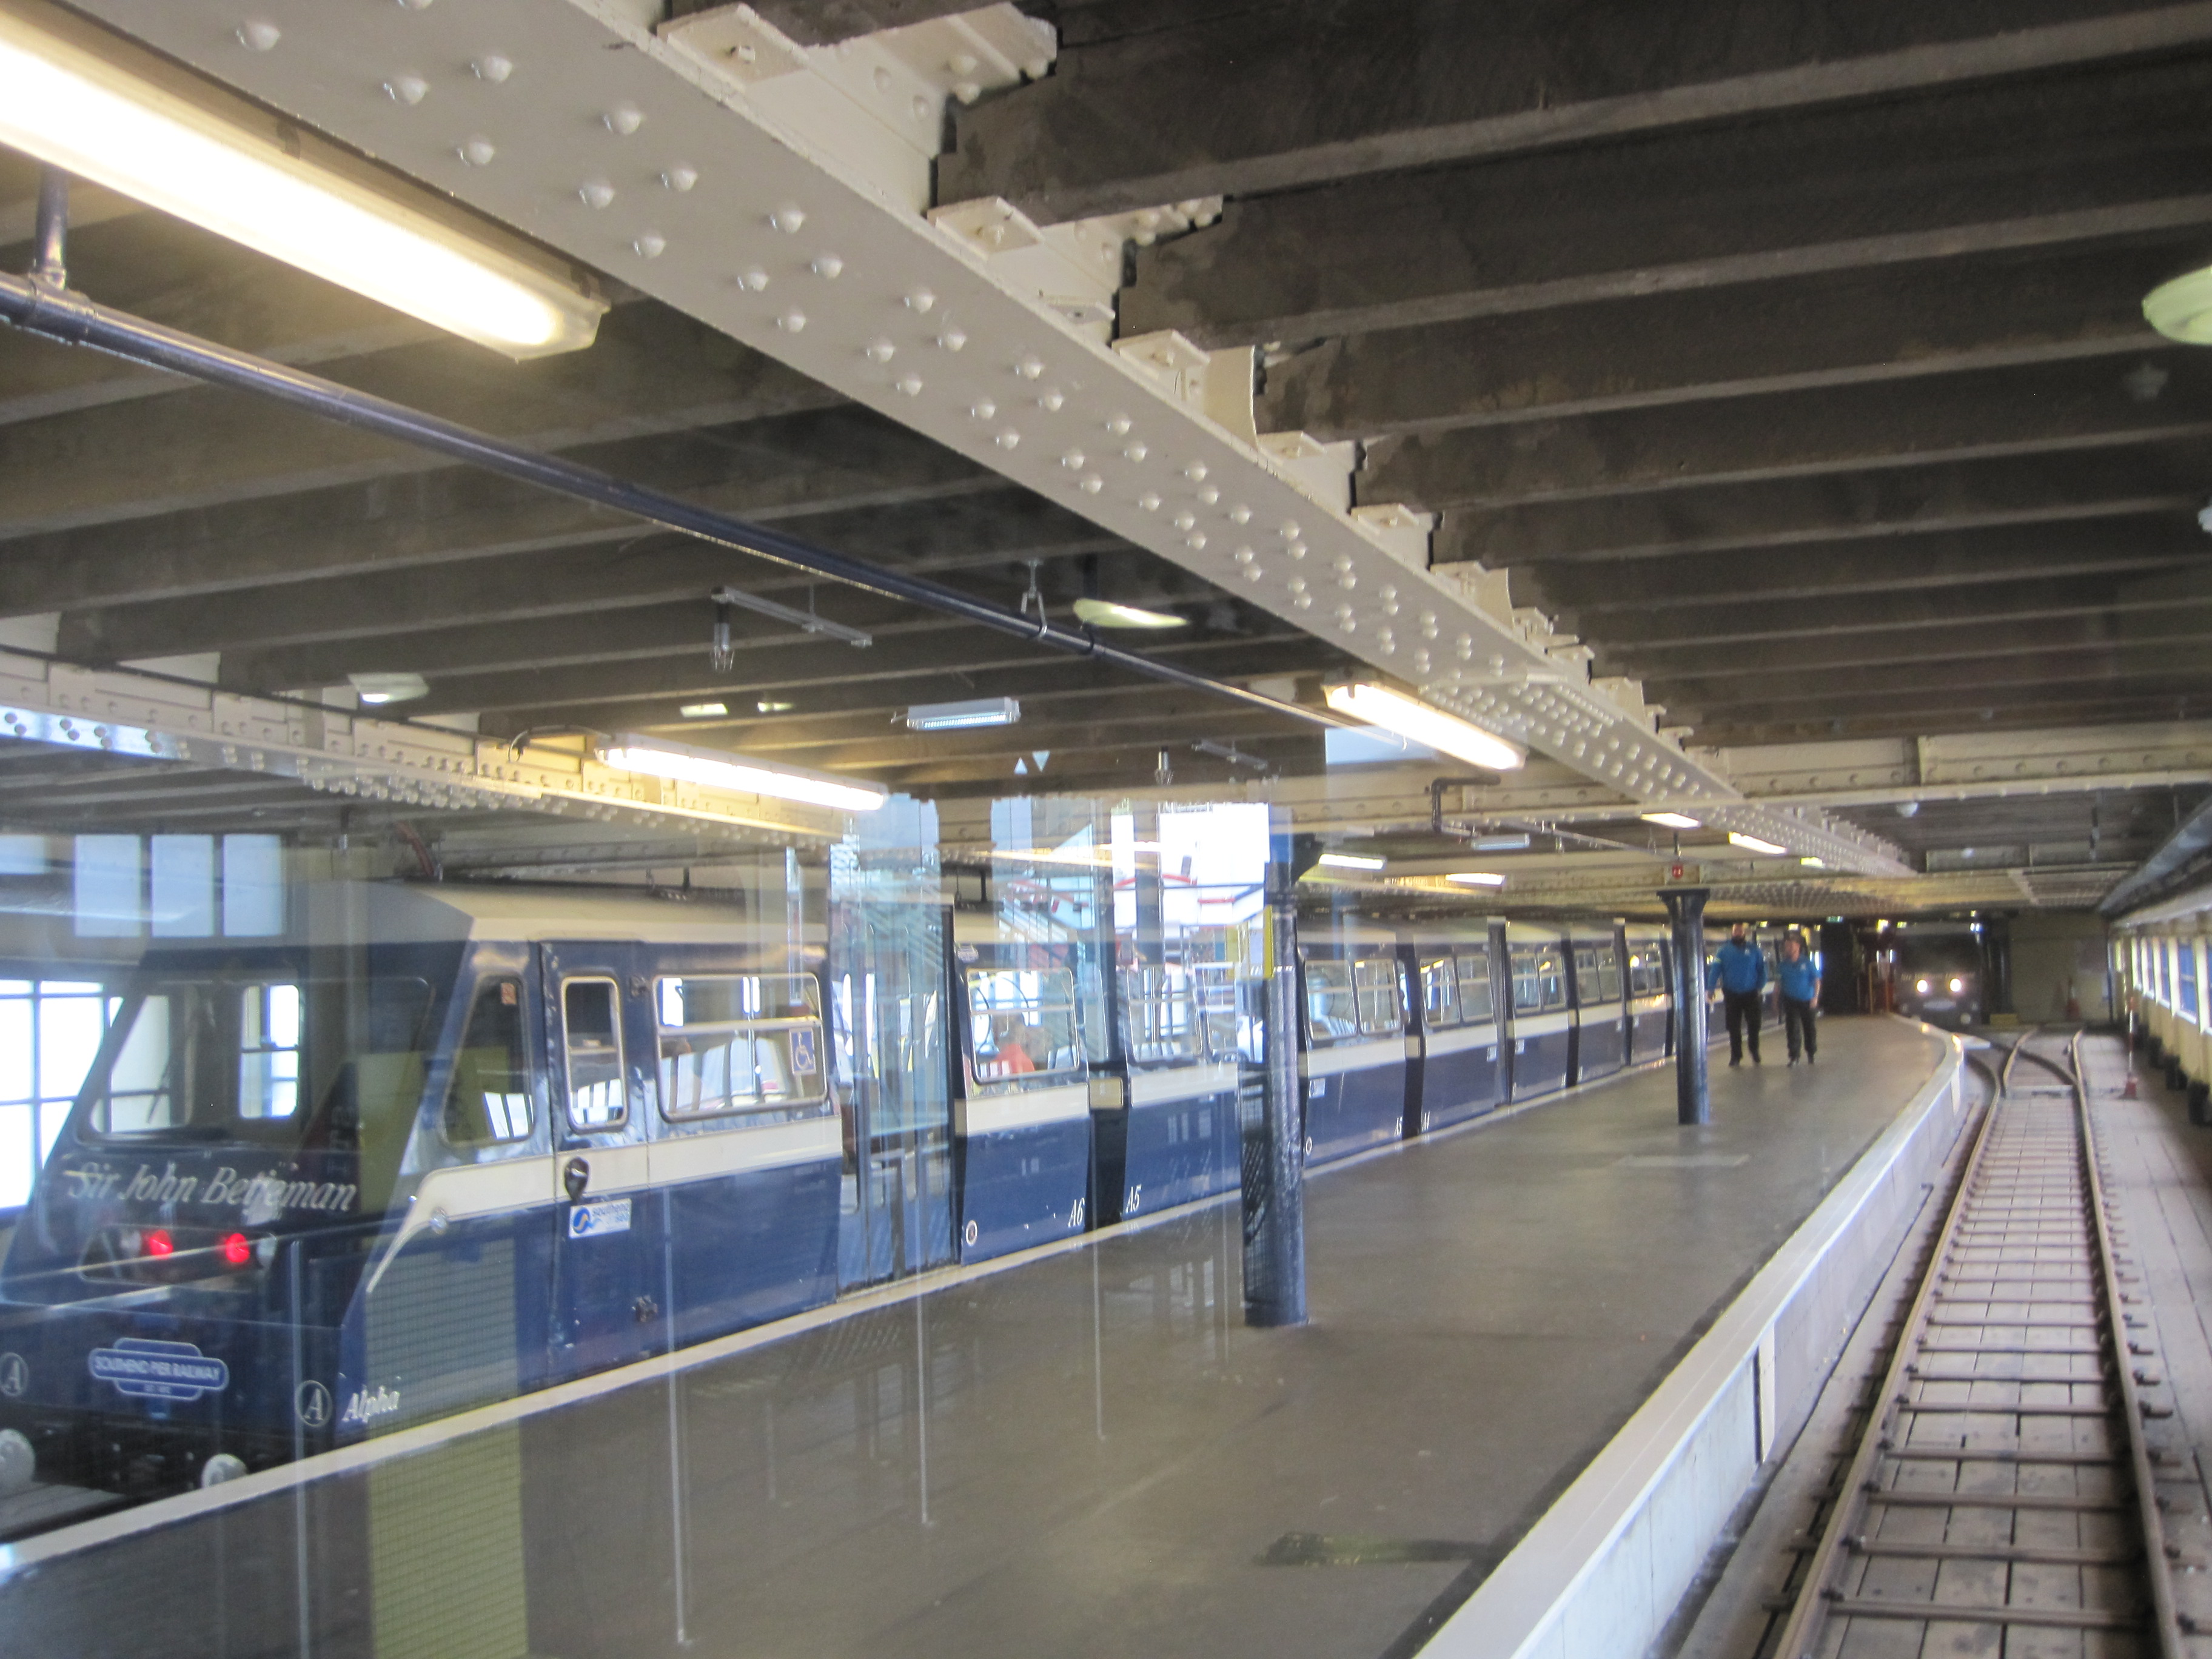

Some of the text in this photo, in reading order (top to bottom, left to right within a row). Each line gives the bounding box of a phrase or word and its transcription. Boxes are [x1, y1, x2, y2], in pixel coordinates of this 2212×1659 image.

[67, 1161, 357, 1214] Sir John Betjeman
[1125, 1184, 1141, 1214] A5
[1068, 1198, 1085, 1227] A6
[1, 1361, 22, 1393] A
[304, 1389, 323, 1421] A
[341, 1385, 400, 1424] Alpha
